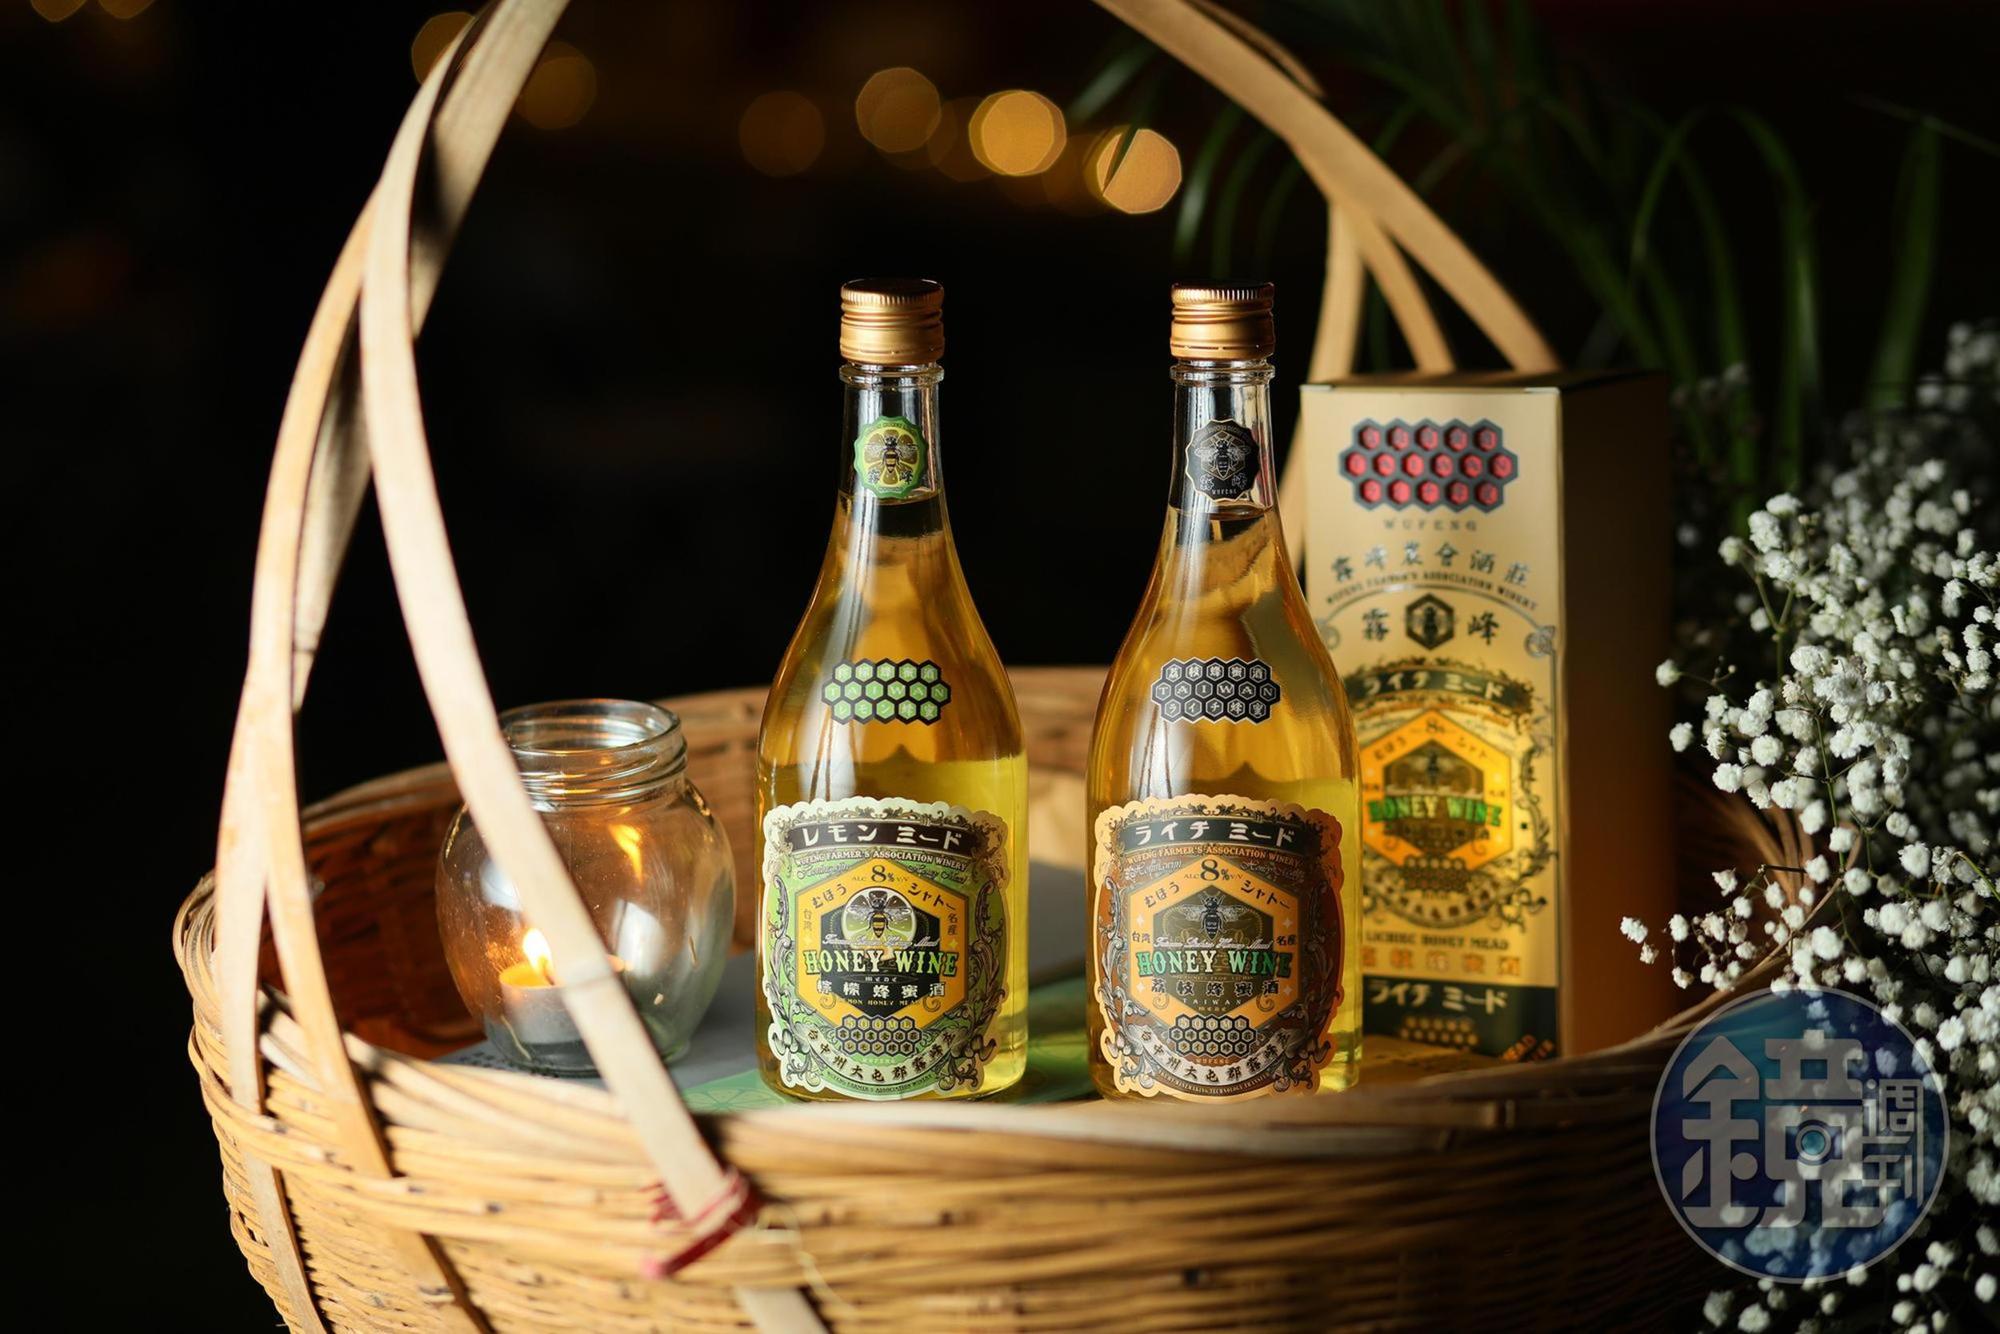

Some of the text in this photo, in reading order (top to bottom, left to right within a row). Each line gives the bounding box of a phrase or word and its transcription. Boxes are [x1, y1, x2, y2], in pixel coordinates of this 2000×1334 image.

[1383, 519, 1478, 531] WUFENG
[1158, 685, 1275, 697] TAIWAN
[1443, 672, 1505, 700] ミード
[1367, 795, 1503, 828] HONEY WINE
[802, 824, 963, 850] レモン ミード
[1134, 819, 1295, 848] ライチ ミード
[826, 850, 870, 860] FARMER'S
[872, 850, 934, 863] ASSOCIATION
[934, 856, 969, 871] WINERY
[1157, 846, 1202, 857] FARMER'S
[1205, 846, 1266, 858] ASSOCIATION
[1268, 851, 1301, 867] WINERY
[1240, 879, 1290, 909] シャトー
[803, 949, 959, 977] HONEY WINE
[1136, 949, 1293, 979] HONEY WINE
[1368, 979, 1510, 1016] ライチ ミード
